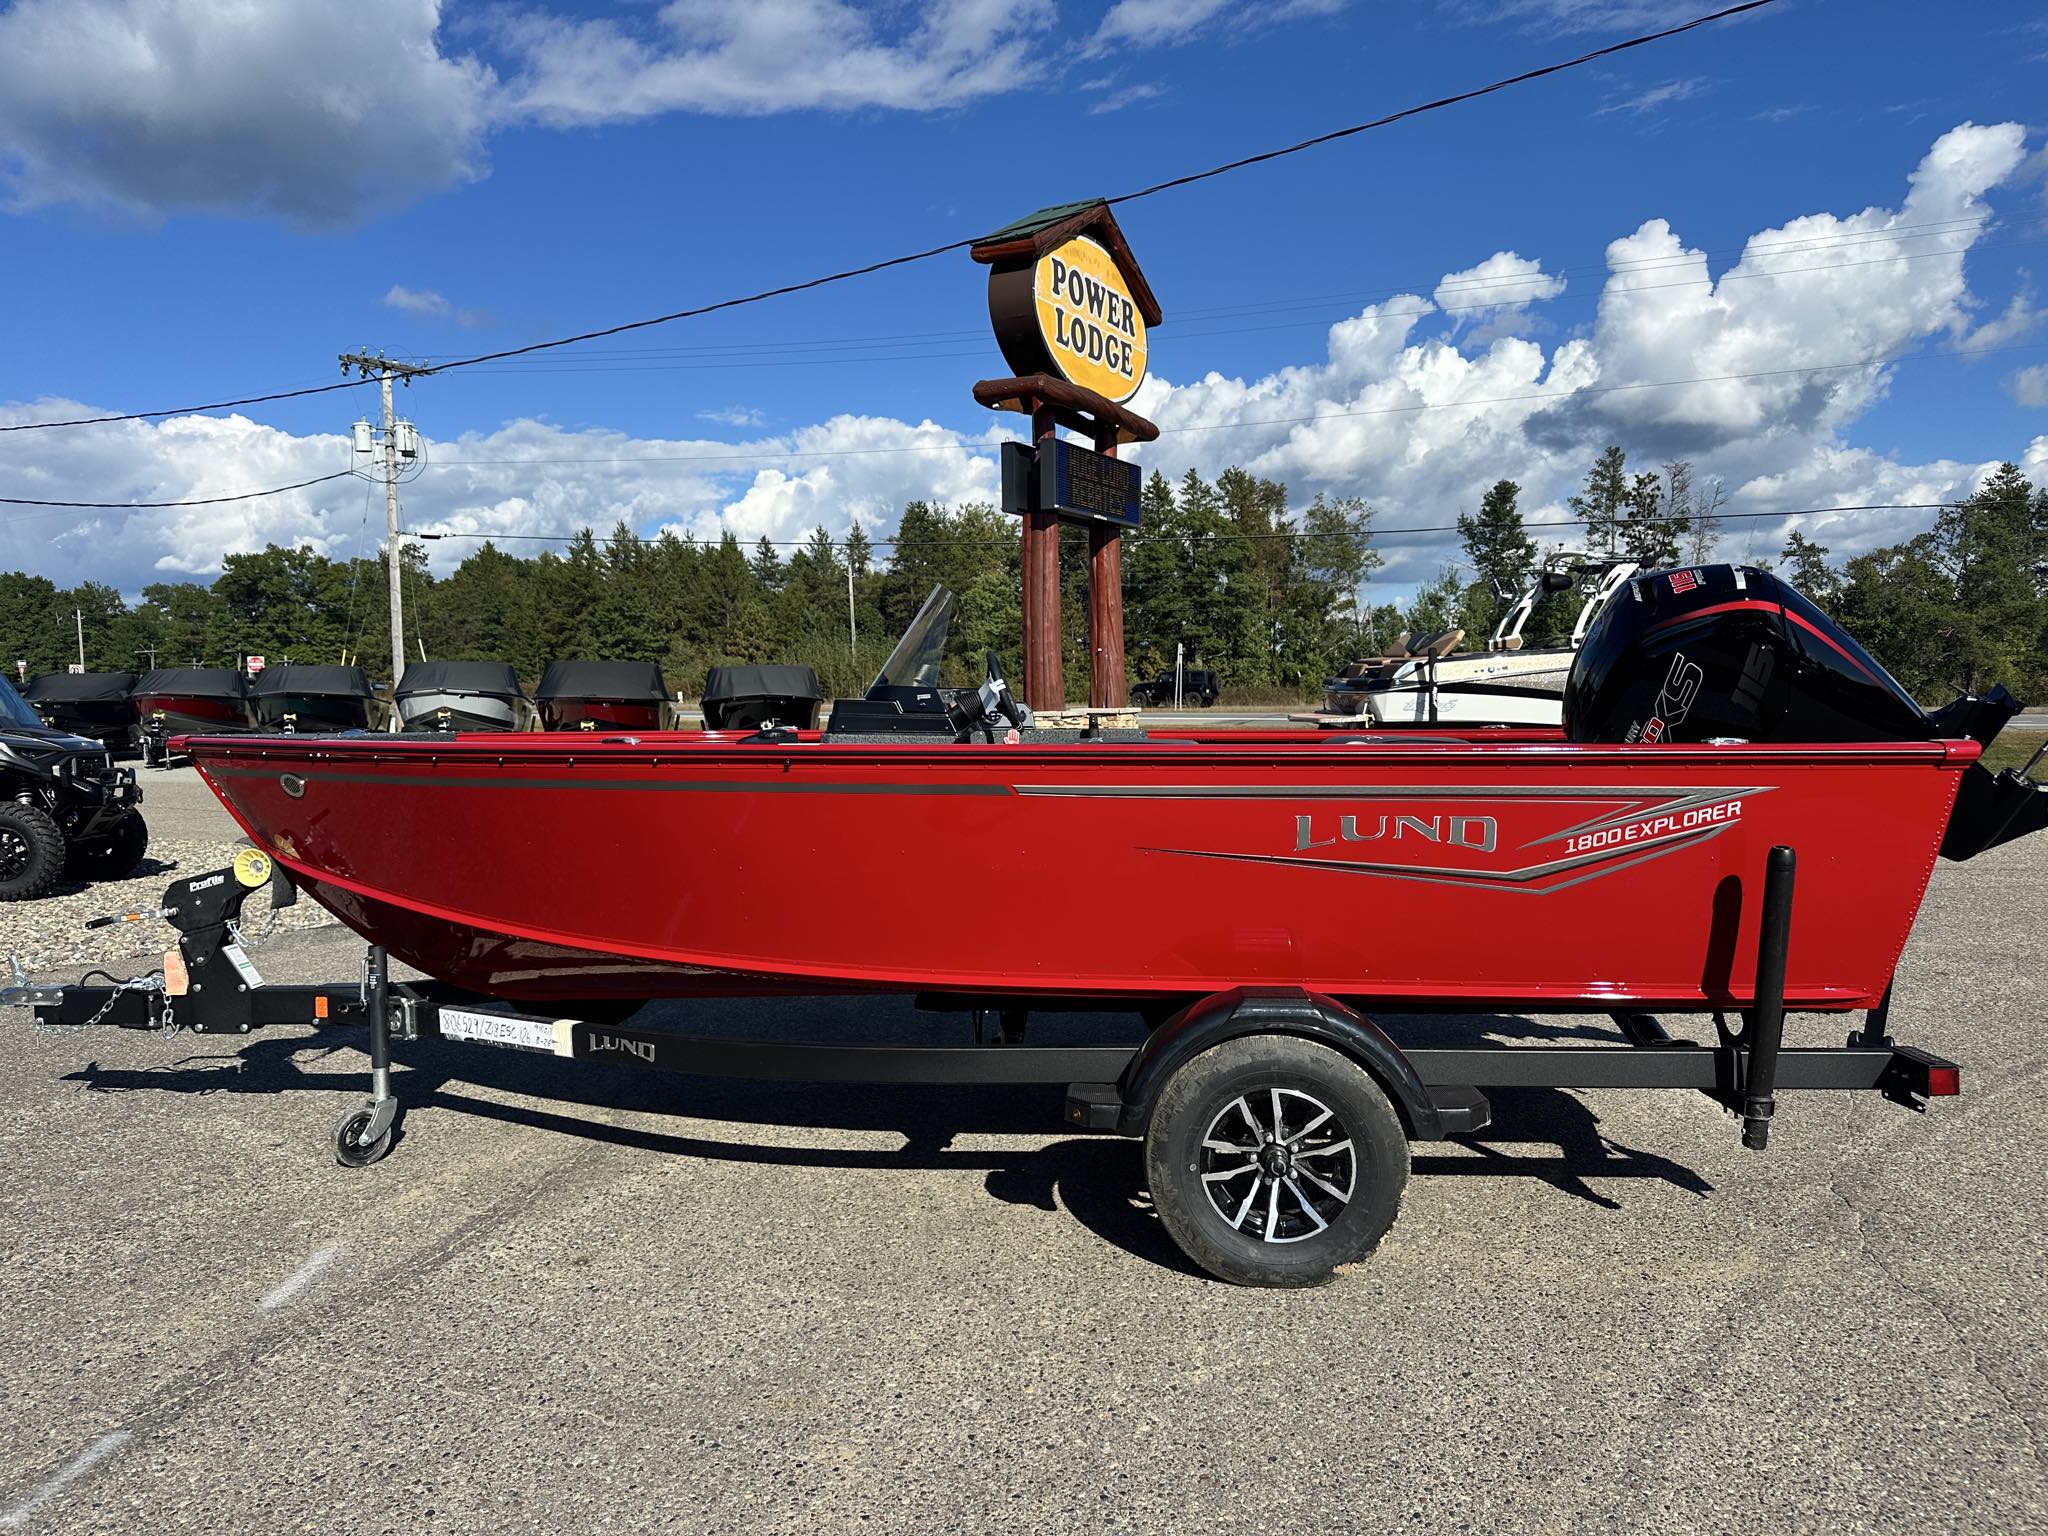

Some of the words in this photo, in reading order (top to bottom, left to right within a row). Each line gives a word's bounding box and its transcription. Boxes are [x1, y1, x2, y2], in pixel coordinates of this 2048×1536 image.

[1052, 258, 1135, 337] POWER
[1055, 308, 1133, 378] LODGE
[1668, 570, 1697, 594] 115
[1731, 642, 1775, 713] 115
[1293, 815, 1498, 852] LUND
[1564, 828, 1622, 854] 1800
[1624, 801, 1742, 841] EXPLORER
[189, 875, 225, 892] Profile
[589, 1034, 655, 1062] LUND
